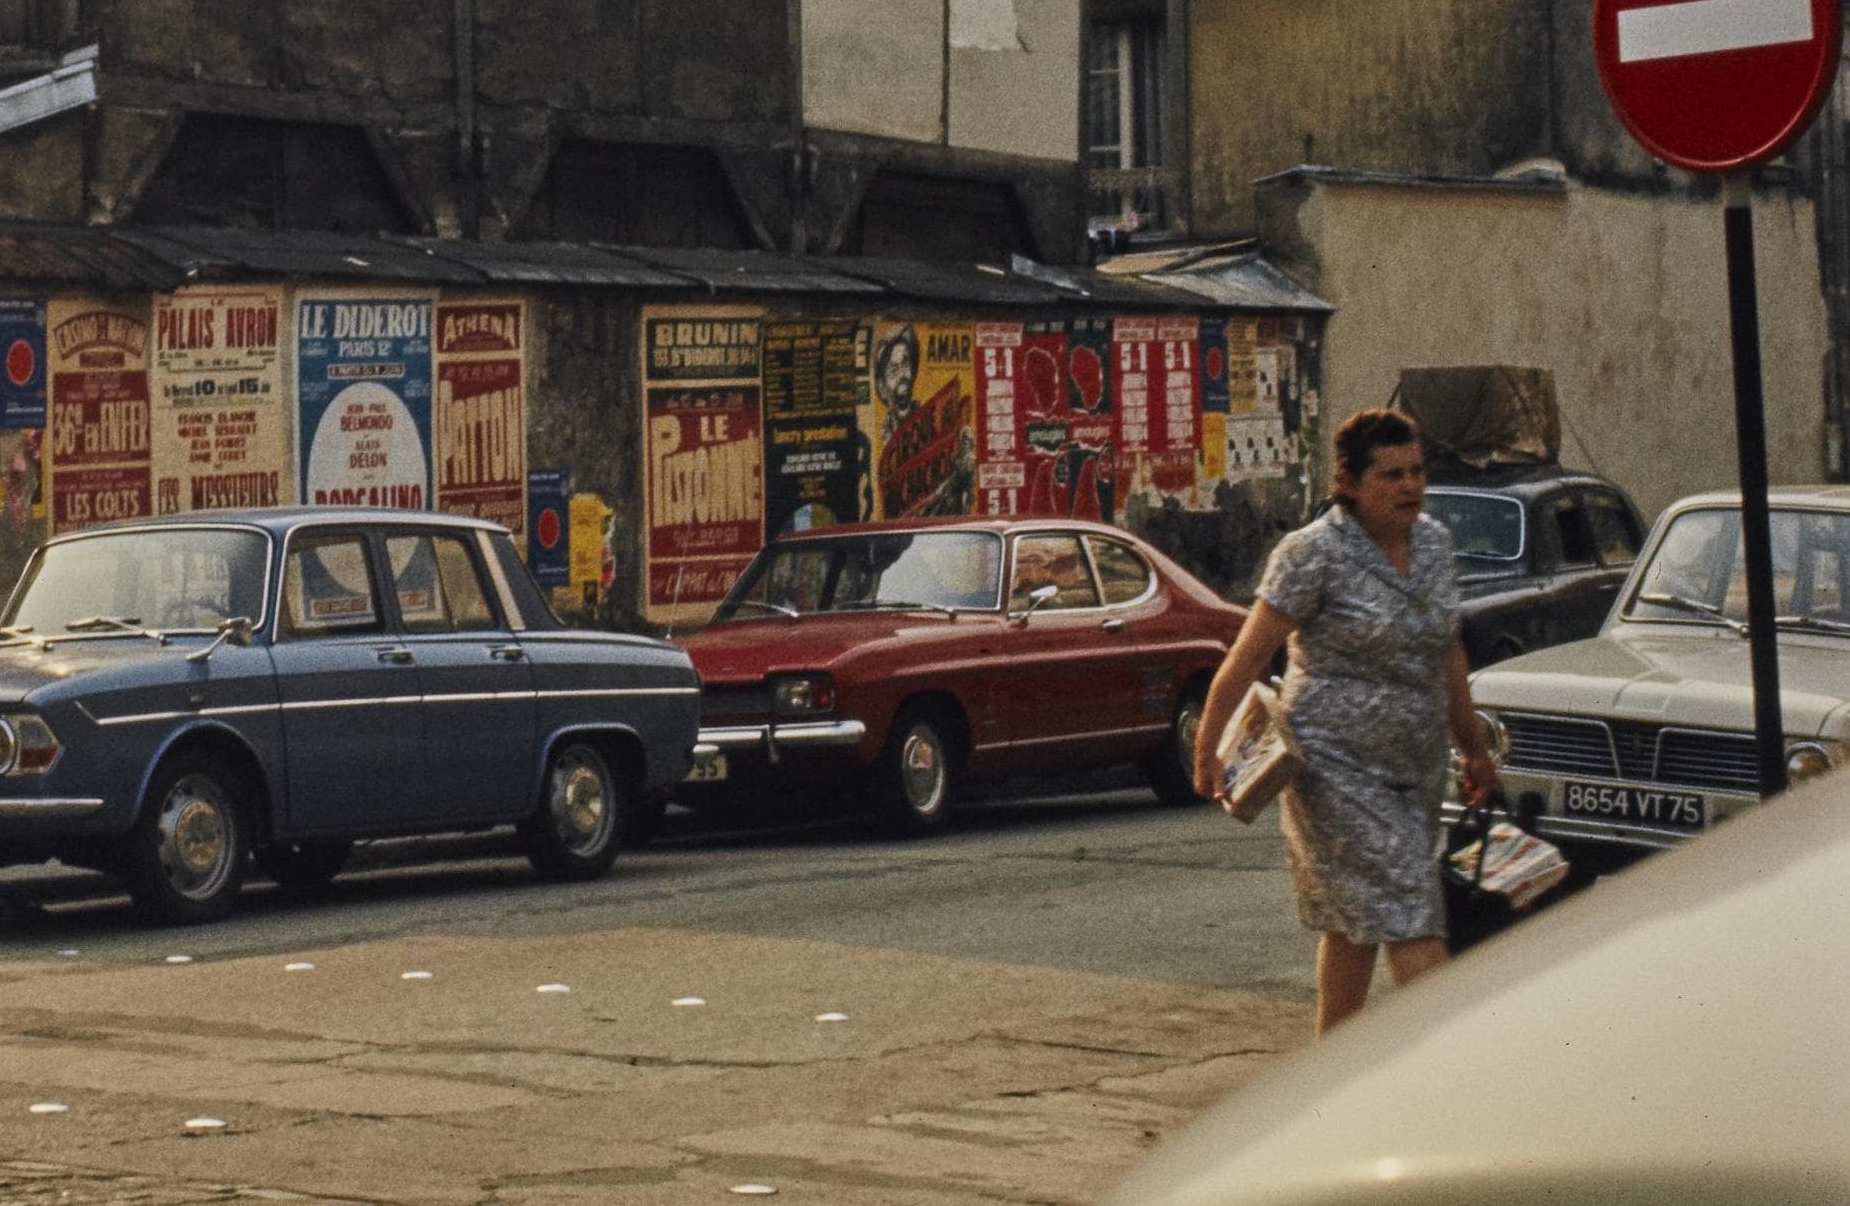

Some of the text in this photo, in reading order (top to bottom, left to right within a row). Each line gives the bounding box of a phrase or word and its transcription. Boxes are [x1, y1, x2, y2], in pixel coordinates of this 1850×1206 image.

[158, 306, 277, 351] PALAIS AVRON
[301, 303, 431, 338] LE DIDEROT
[442, 313, 516, 351] ATHENA
[655, 322, 759, 346] BRUNIN
[338, 340, 376, 359] PARIS
[926, 334, 970, 363] AMAR
[195, 379, 216, 396] 10
[100, 400, 148, 453] ENFER
[340, 414, 393, 432] BELMONDO
[440, 380, 521, 486] PATTON
[700, 414, 729, 442] LE
[349, 451, 387, 469] DELON
[66, 489, 140, 522] LES COLTS
[1568, 784, 1629, 816] 8654
